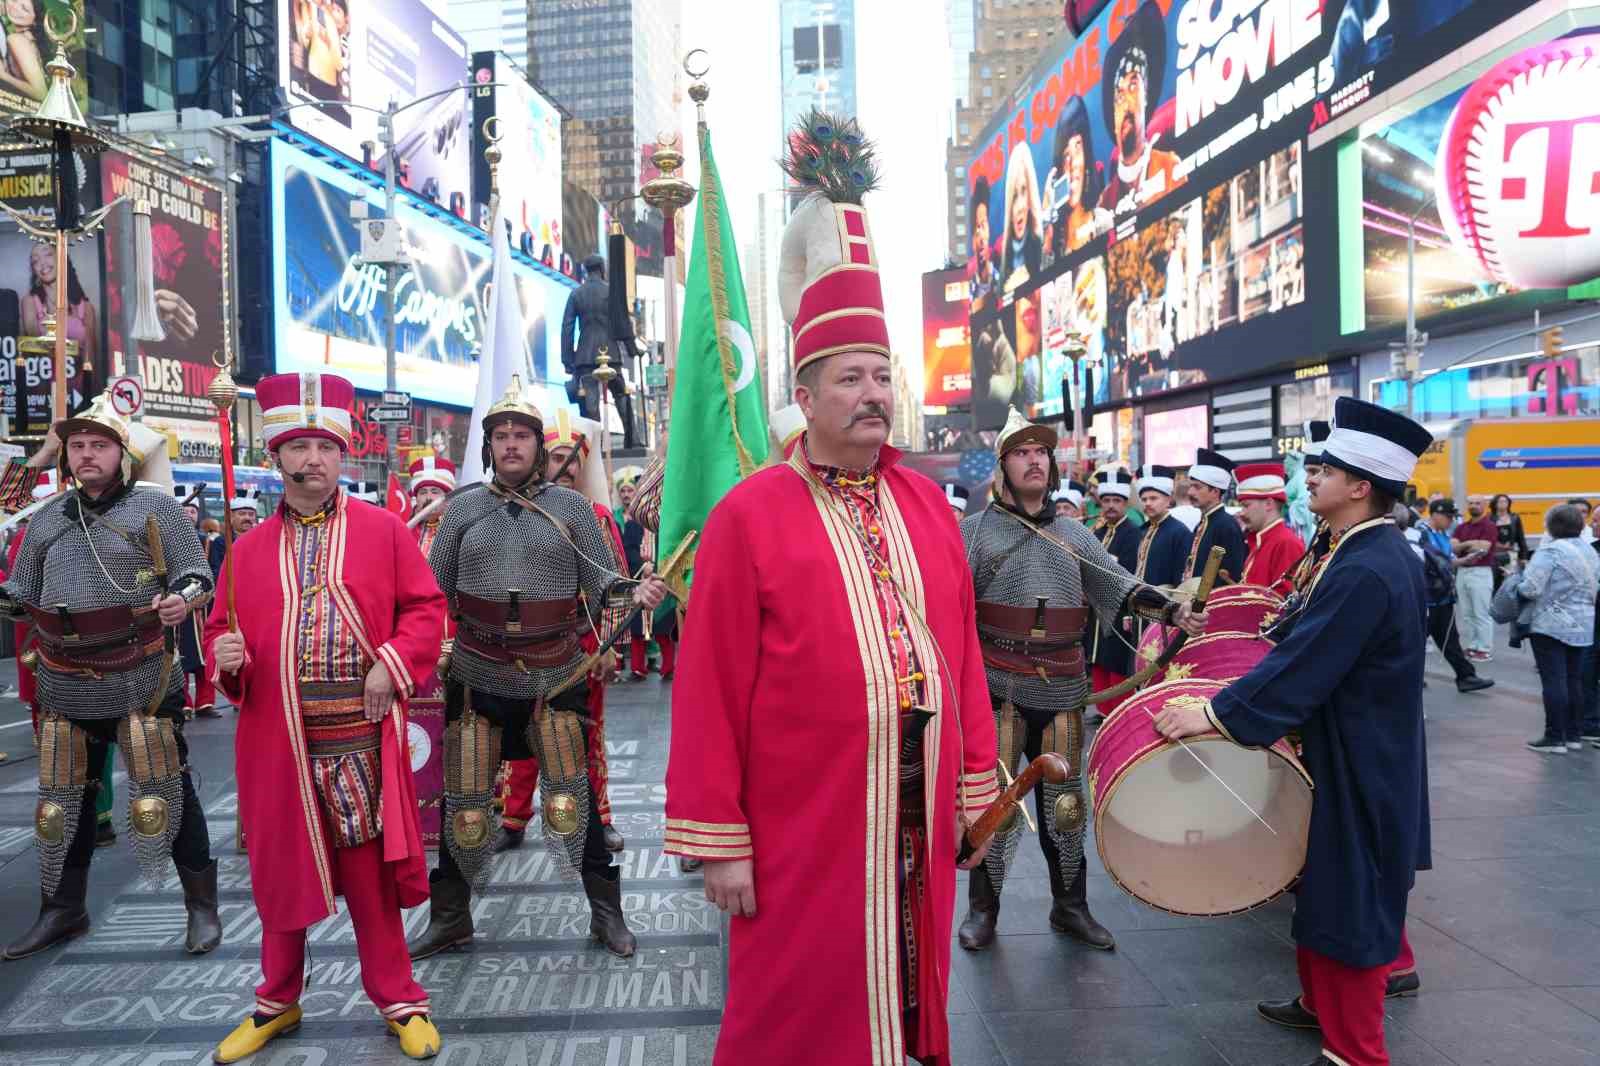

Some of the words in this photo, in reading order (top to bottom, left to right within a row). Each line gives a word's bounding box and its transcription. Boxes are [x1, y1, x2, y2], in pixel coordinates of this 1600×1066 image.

[1175, 0, 1322, 137] MOVIE
[476, 86, 491, 97] LG
[127, 161, 152, 185] COME
[153, 171, 169, 192] SEE
[111, 172, 159, 209] WORLD
[161, 193, 201, 225] COULD
[203, 209, 219, 231] BE
[1295, 363, 1329, 380] SEPHORA
[672, 951, 695, 968] J
[453, 969, 710, 1014] FRIEDMAN
